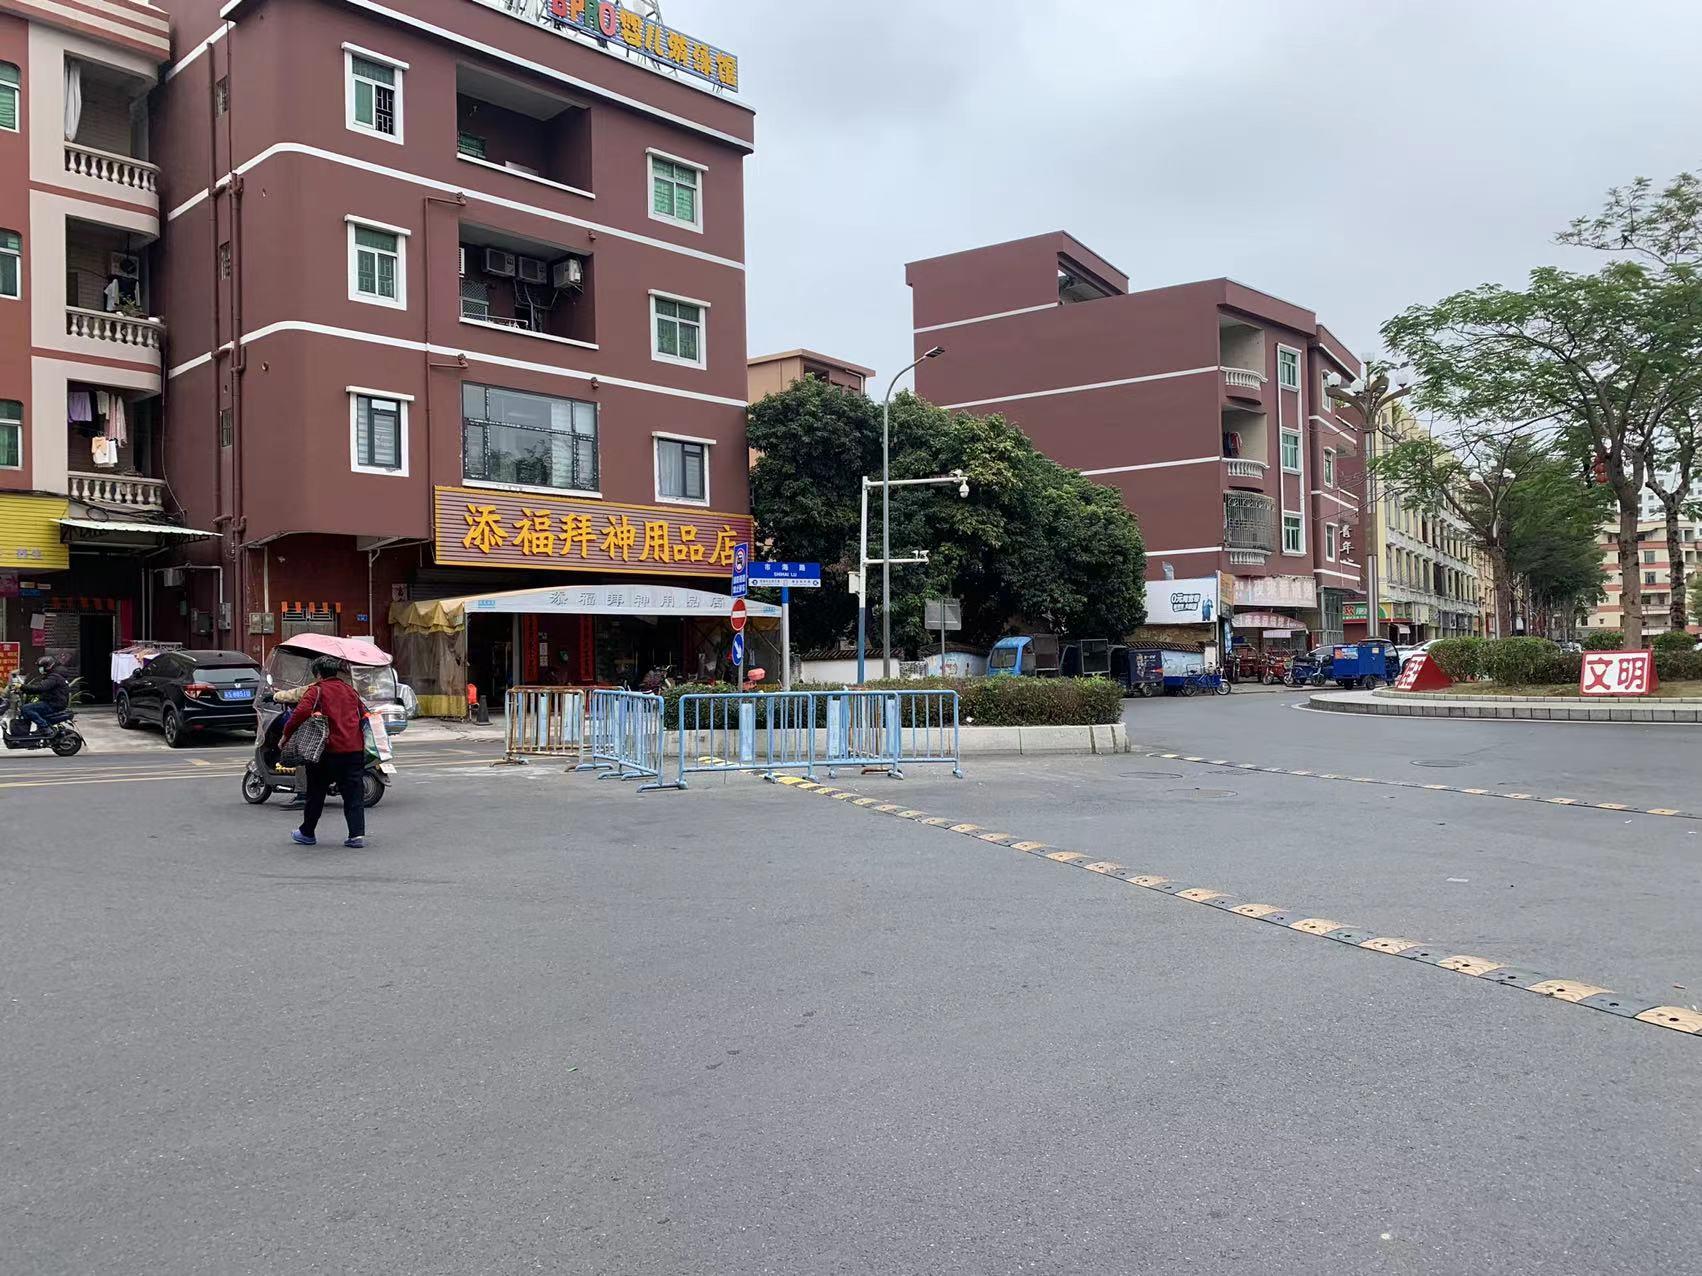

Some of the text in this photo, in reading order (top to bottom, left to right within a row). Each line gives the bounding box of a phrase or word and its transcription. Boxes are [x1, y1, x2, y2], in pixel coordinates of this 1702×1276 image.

[462, 503, 738, 566] 添福拜神用品店
[550, 591, 725, 609] 添福拜神用品店
[1585, 657, 1646, 690] 文明
